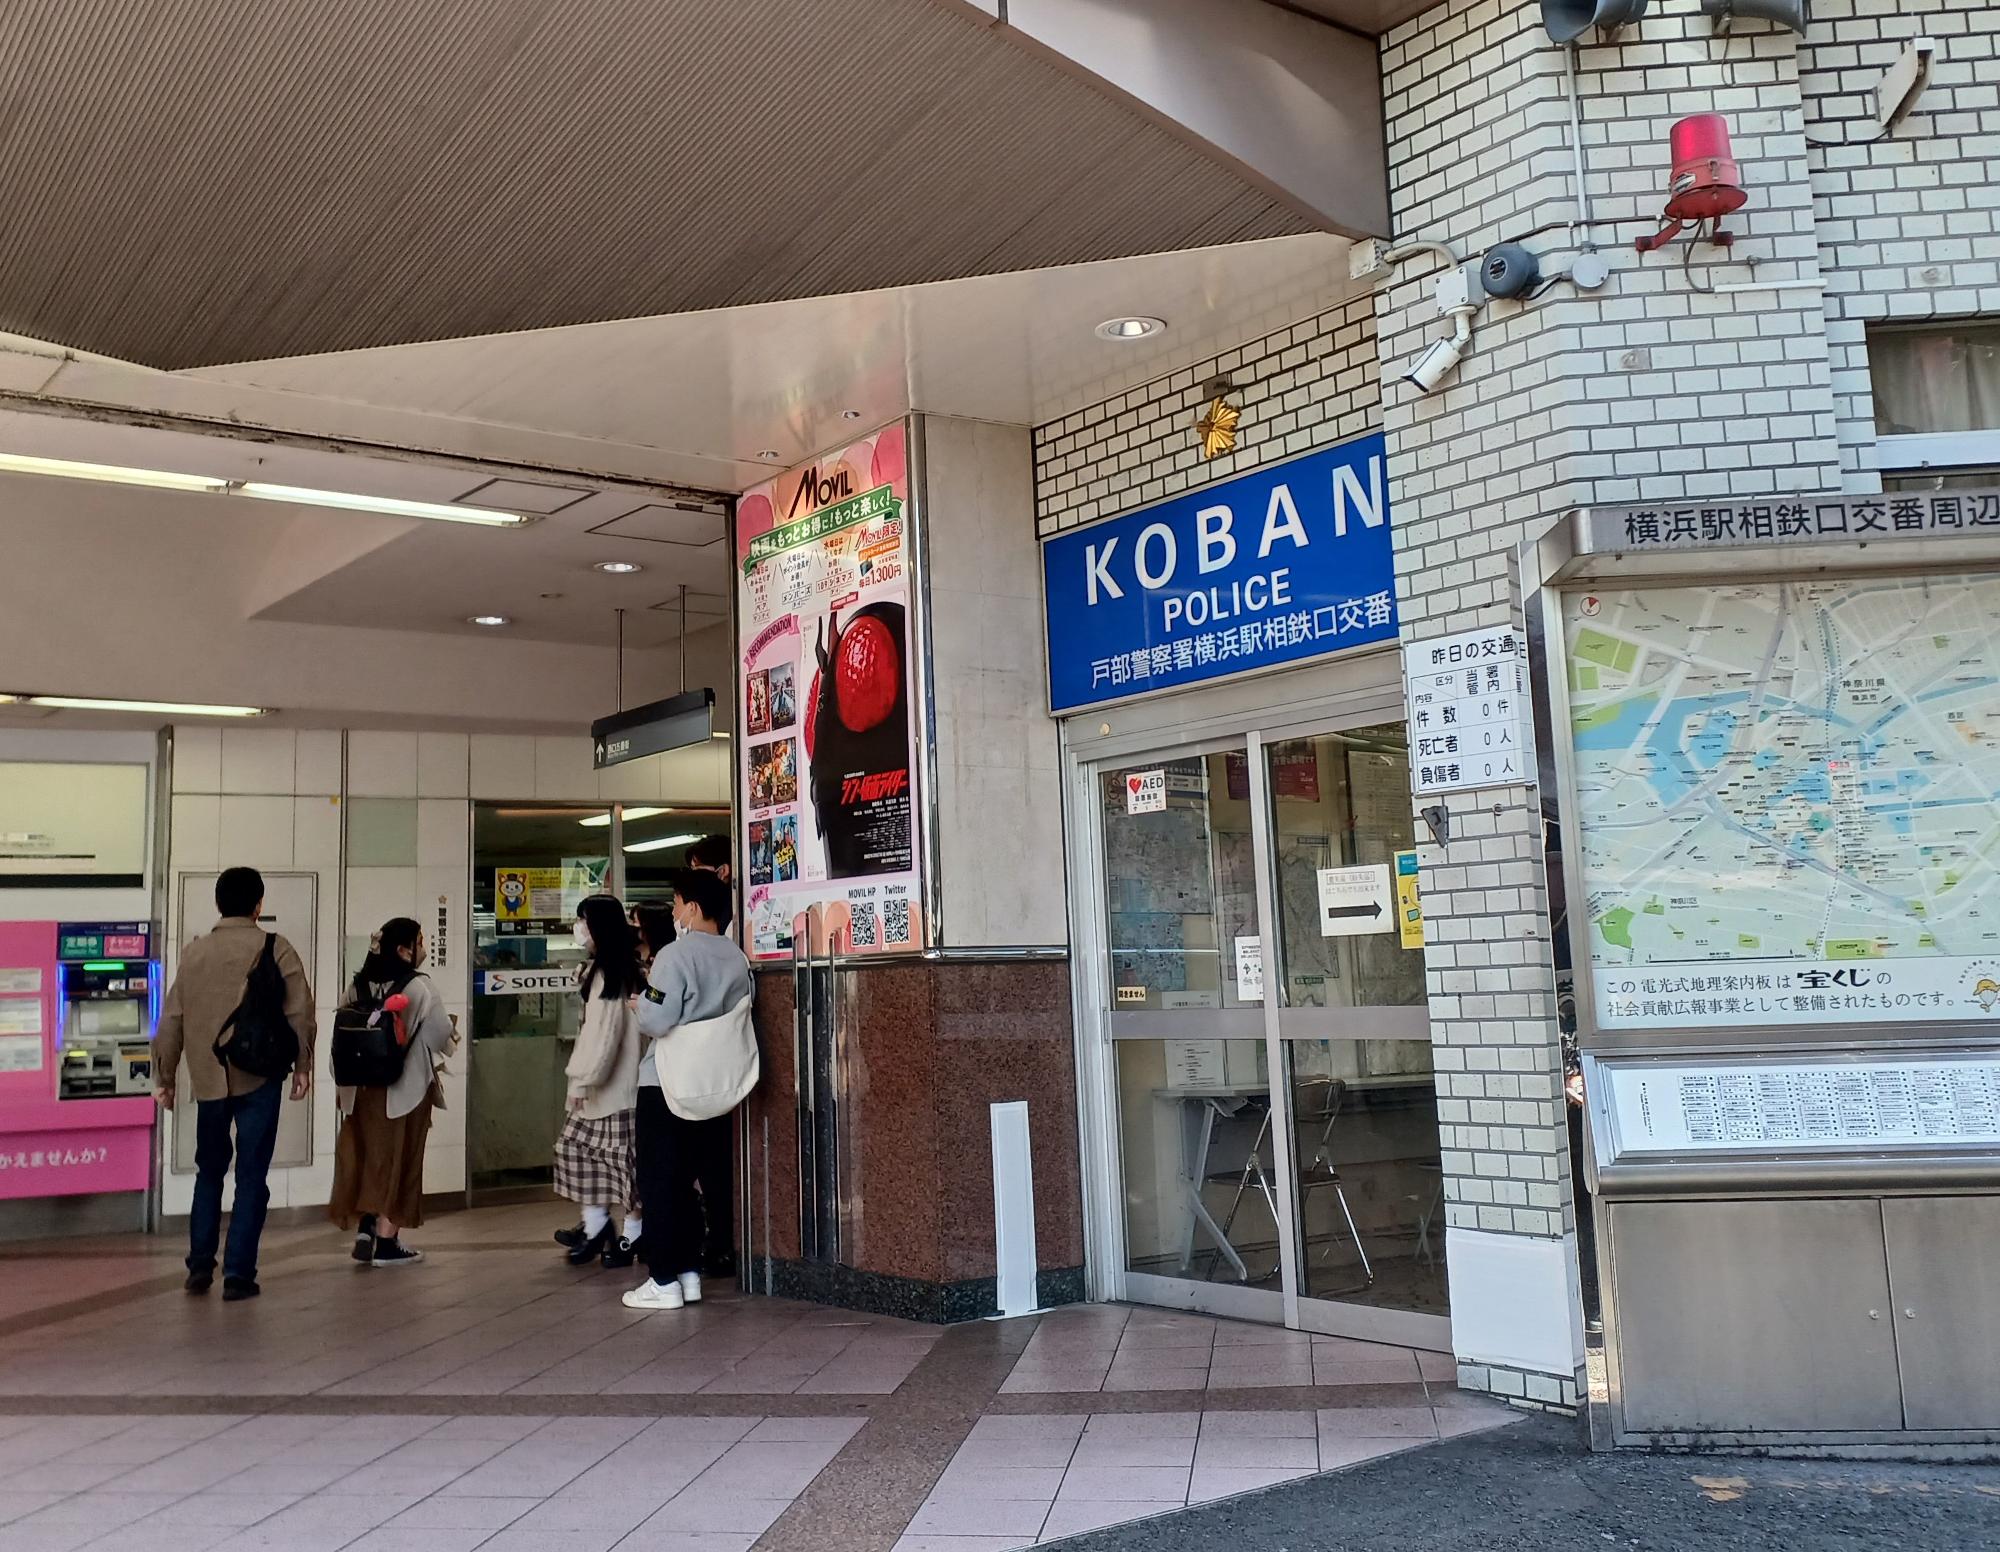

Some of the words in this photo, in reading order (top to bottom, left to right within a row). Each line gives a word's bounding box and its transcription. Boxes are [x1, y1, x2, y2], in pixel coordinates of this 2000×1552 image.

[1085, 454, 1385, 606] KOBAN
[1624, 494, 2000, 545] 横浜駅相鉄口交番周辺
[1163, 568, 1291, 632] POLICE
[1091, 590, 1393, 690] 戸部警察署横浜駅相鉄口交番
[1436, 675, 1453, 686] 区分
[1415, 693, 1432, 704] 内容
[1418, 734, 1458, 757] 死亡者
[1141, 776, 1164, 791] AED
[1420, 763, 1461, 785] 負傷者
[848, 888, 867, 898] MOVIL
[867, 886, 876, 897] HP
[885, 884, 907, 895] Twitter
